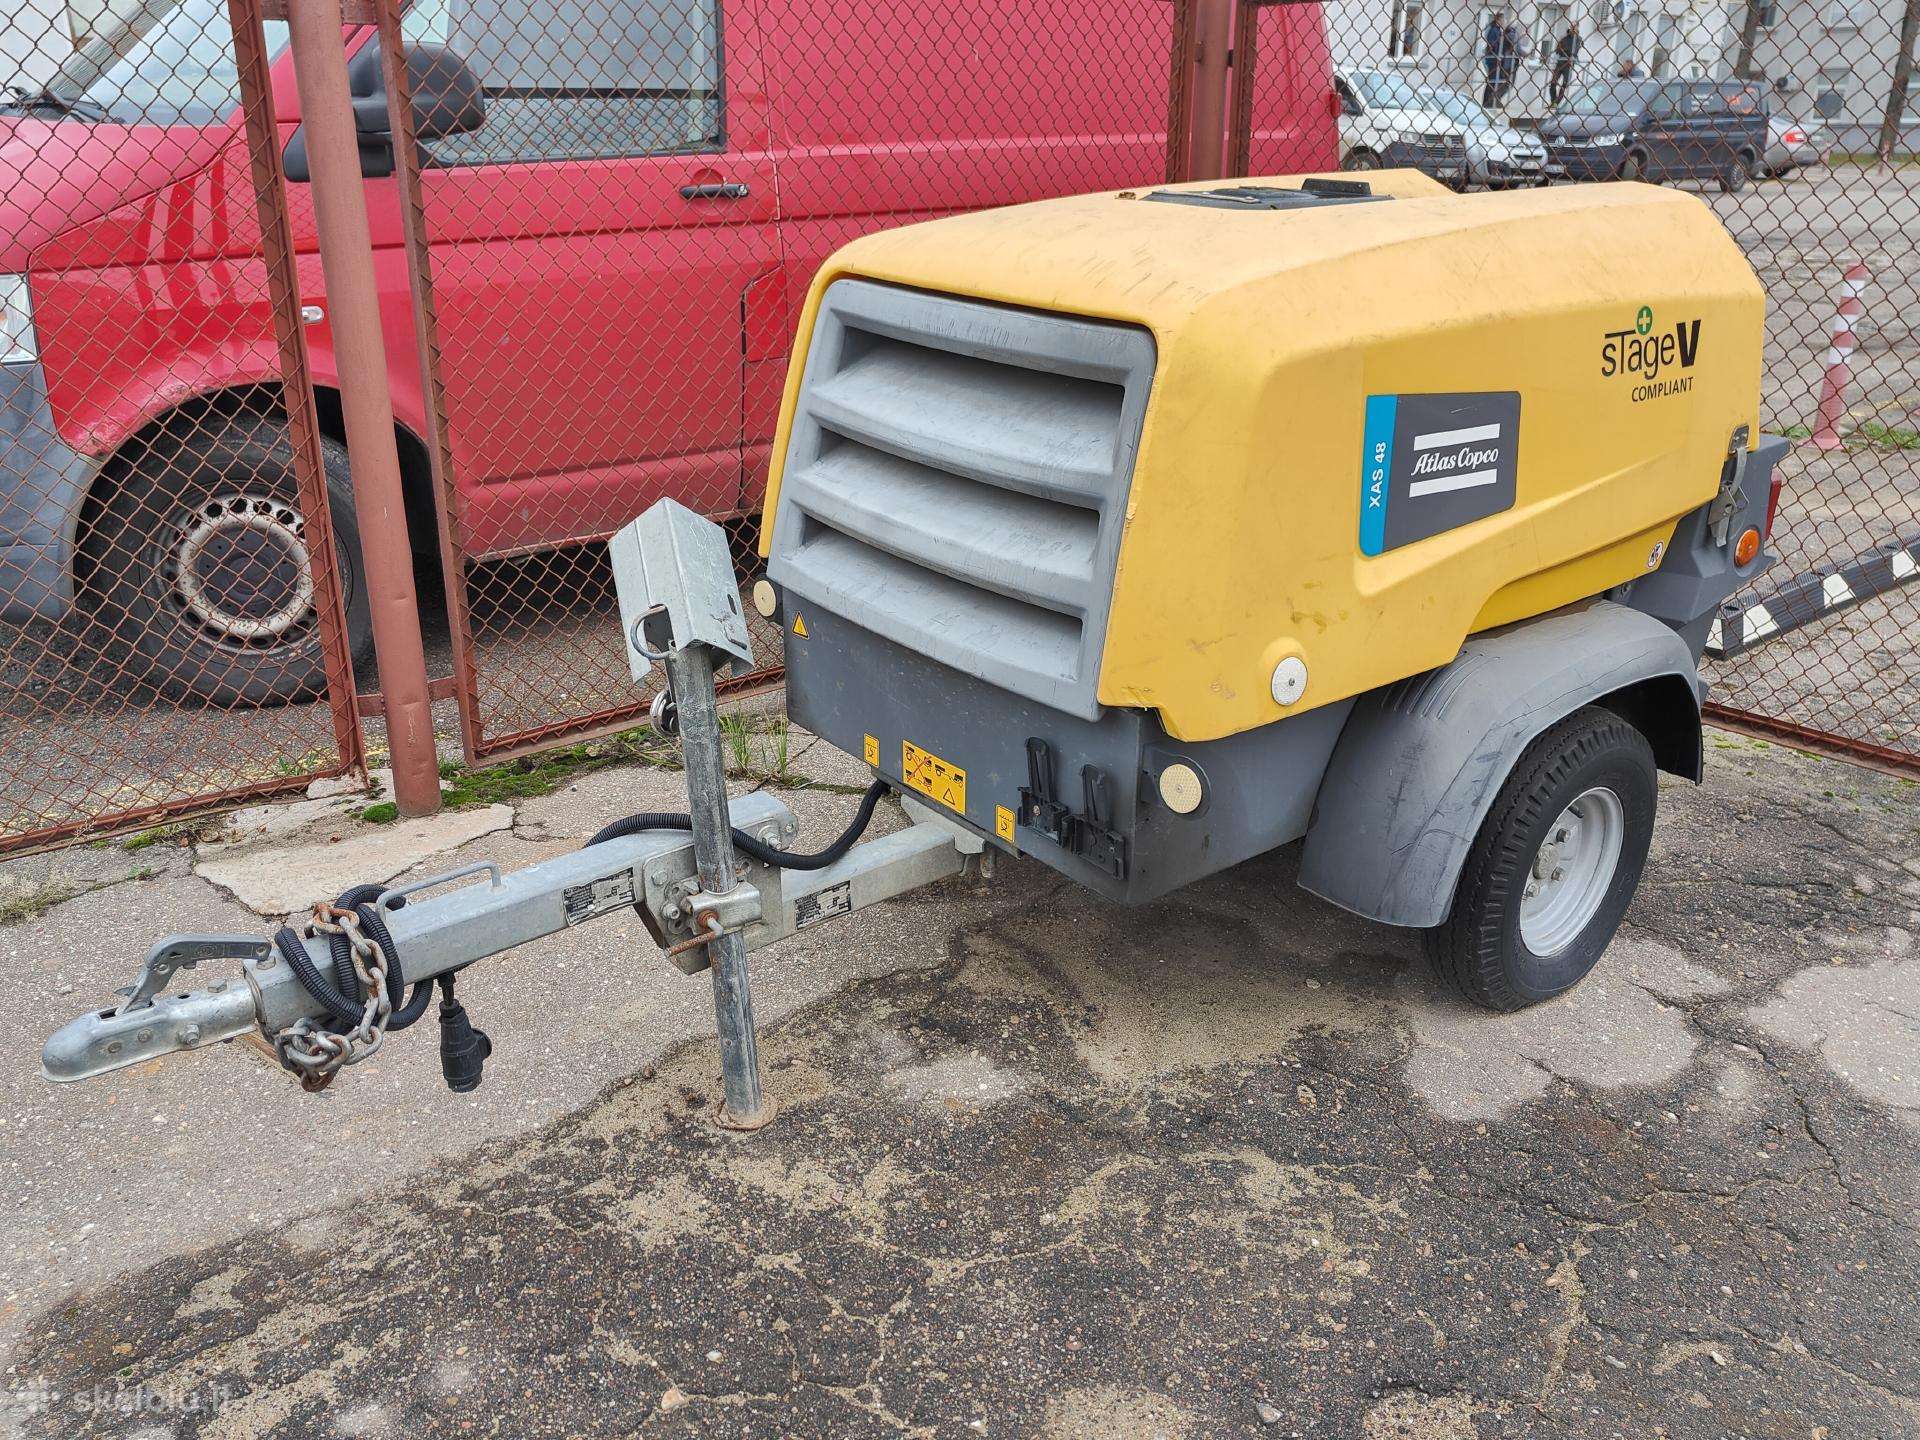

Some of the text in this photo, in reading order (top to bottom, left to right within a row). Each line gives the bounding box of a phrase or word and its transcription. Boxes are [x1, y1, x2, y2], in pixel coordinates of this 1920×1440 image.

[1676, 319, 1702, 368] V
[1631, 376, 1694, 402] COMPLIANT
[1369, 442, 1386, 509] XAS 48
[1411, 446, 1499, 476] Atlas Copco
